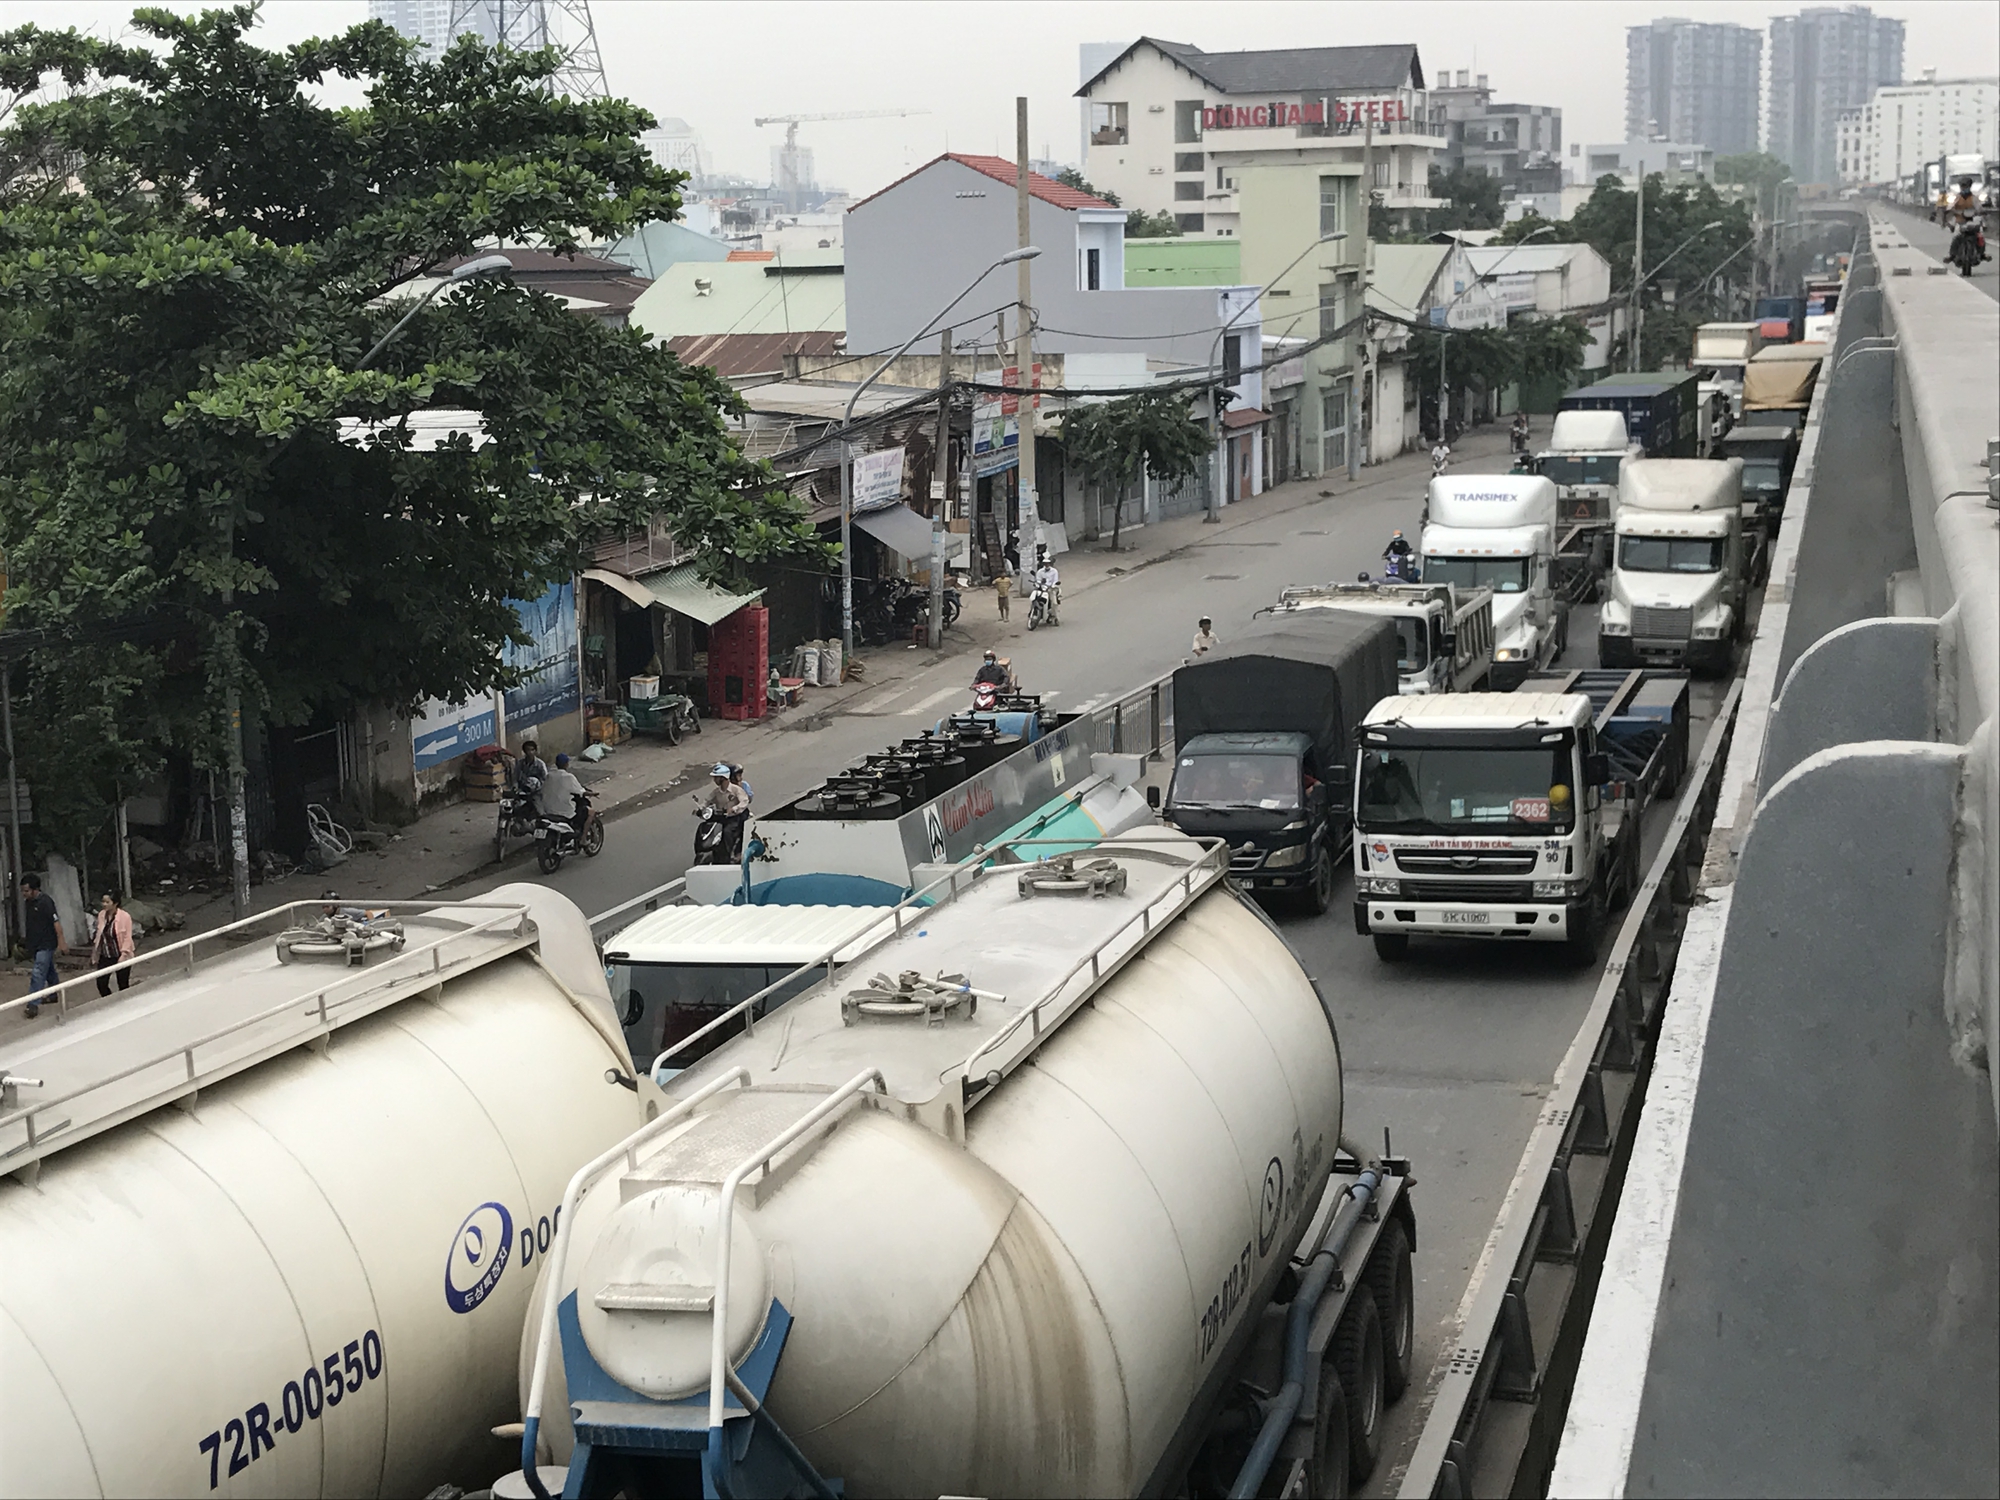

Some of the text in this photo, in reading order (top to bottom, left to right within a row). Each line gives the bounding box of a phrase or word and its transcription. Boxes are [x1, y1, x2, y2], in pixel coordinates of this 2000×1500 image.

[1335, 99, 1410, 122] STEEL
[1453, 493, 1518, 502] TRANSIMEX
[464, 718, 492, 744] 300 M
[1515, 802, 1548, 818] 2362
[1544, 840, 1560, 850] SM
[1545, 852, 1559, 863] 90
[199, 1329, 383, 1491] 72R-00550
